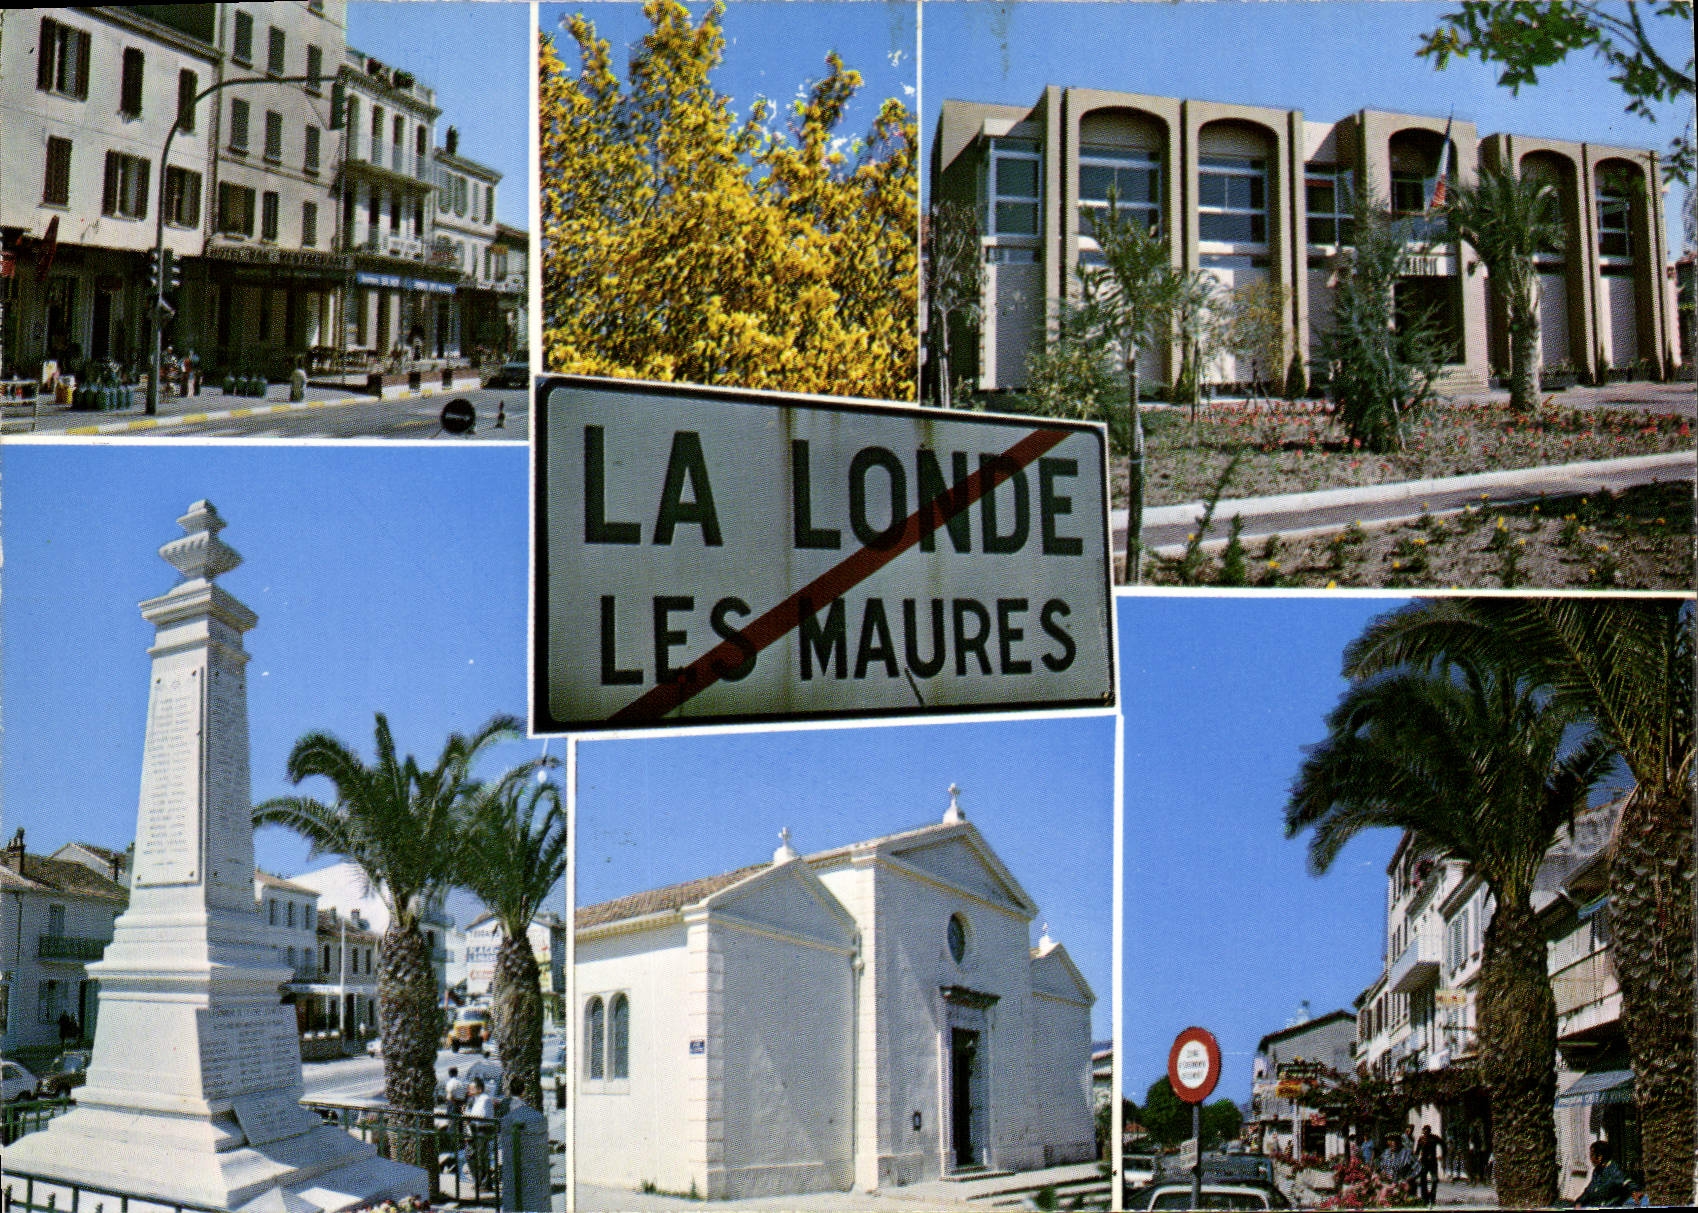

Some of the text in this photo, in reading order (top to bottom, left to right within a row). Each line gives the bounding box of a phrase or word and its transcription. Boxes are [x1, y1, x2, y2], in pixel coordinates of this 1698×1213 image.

[584, 425, 1083, 557] LA LONDE
[600, 595, 1077, 685] LES MAURES
